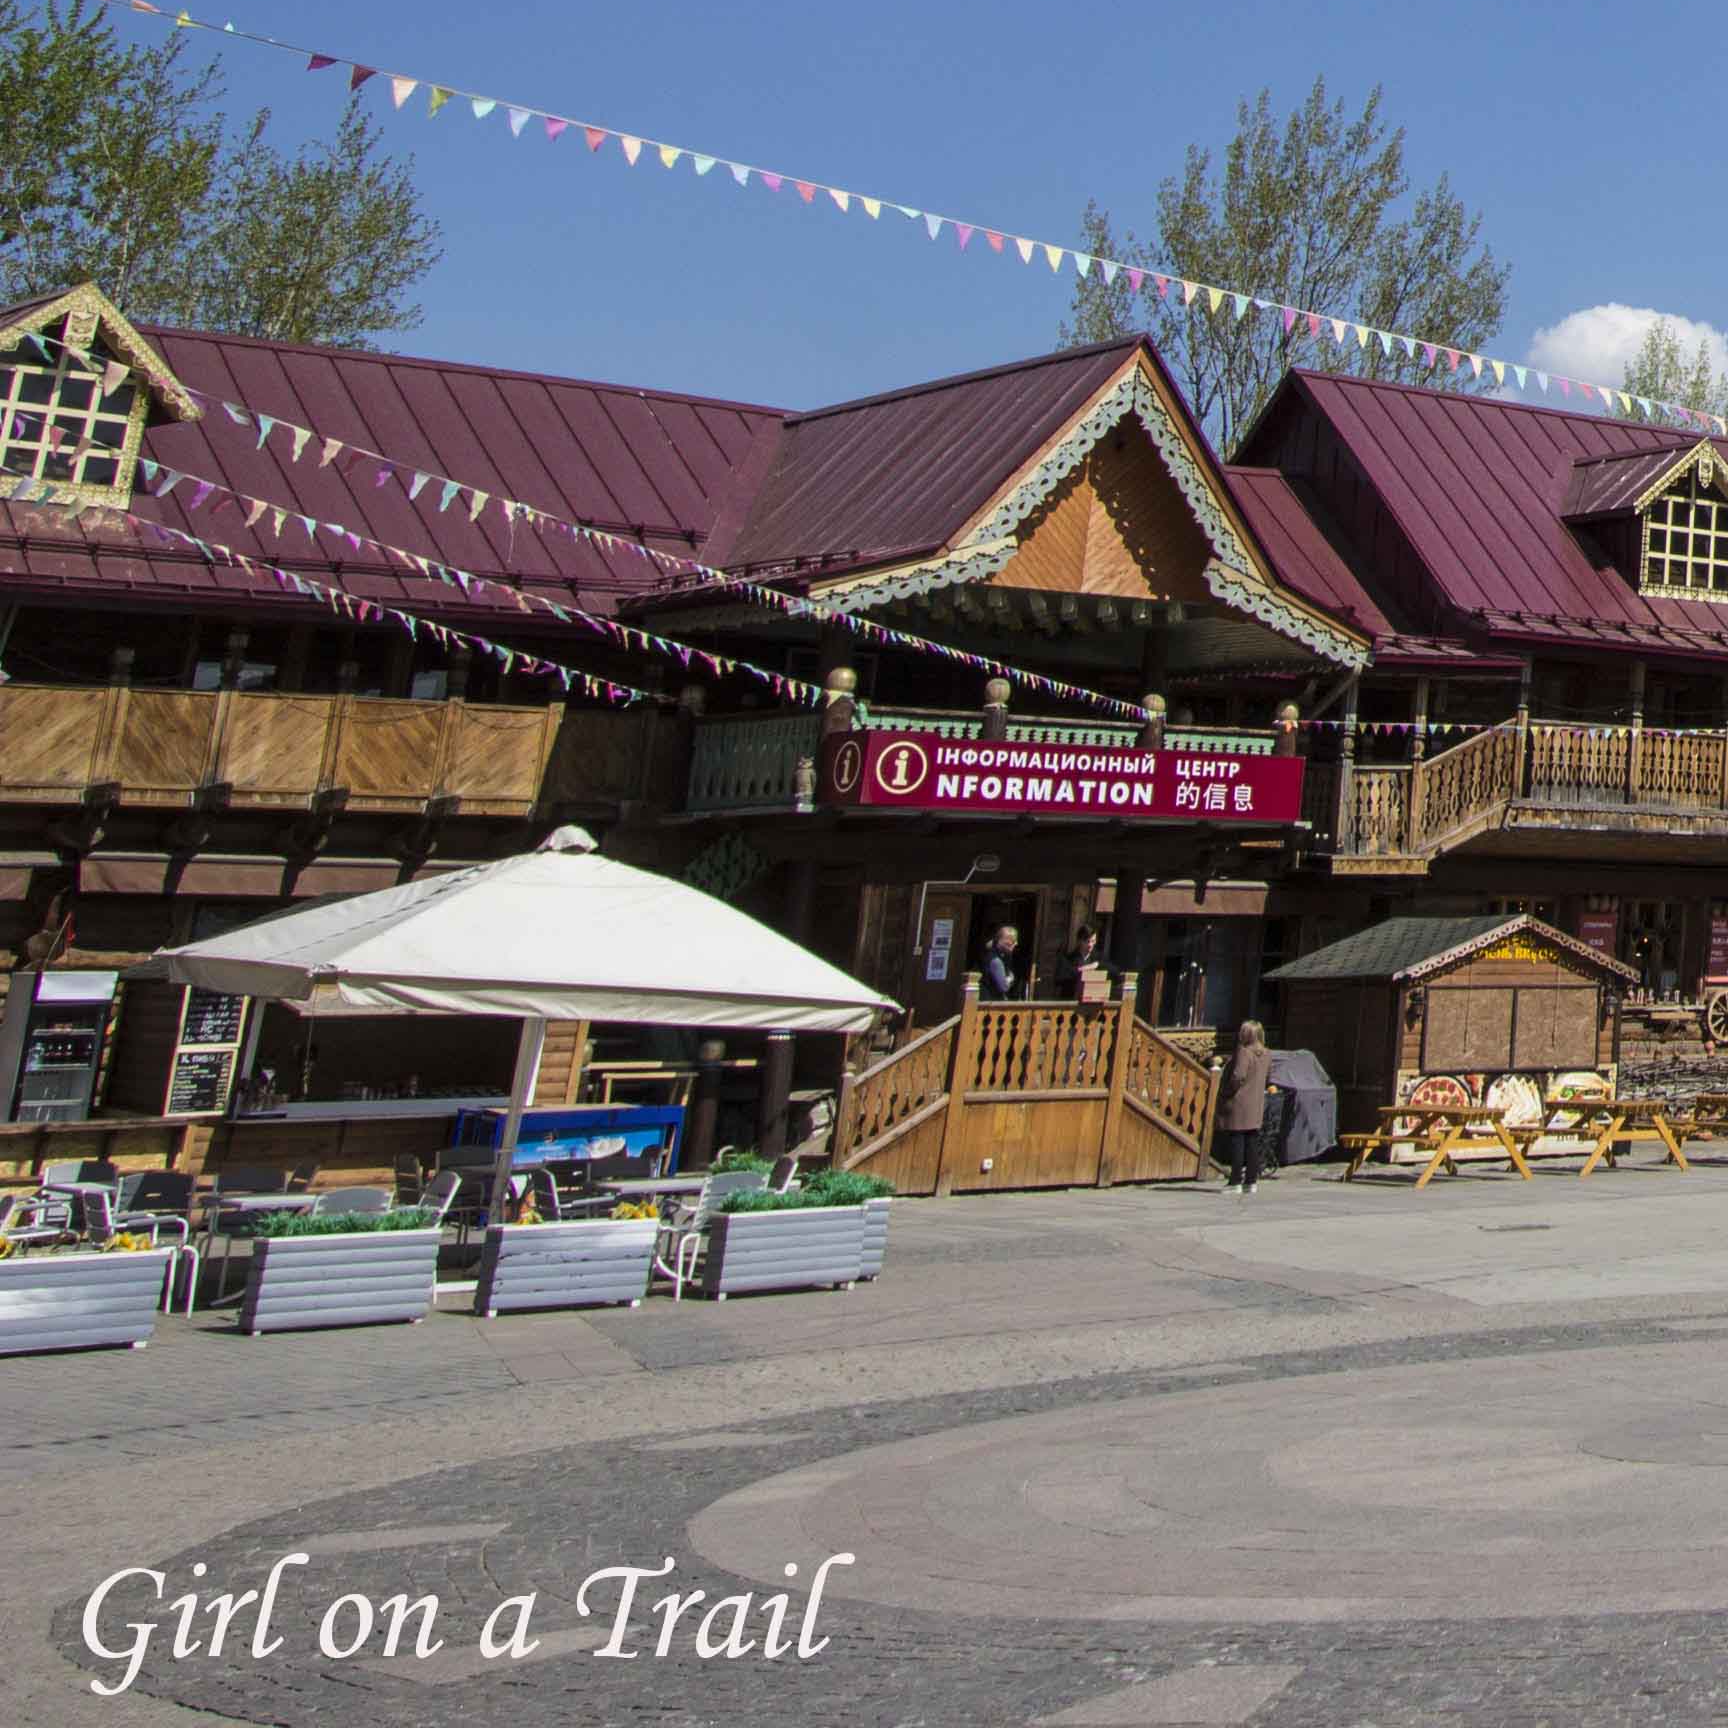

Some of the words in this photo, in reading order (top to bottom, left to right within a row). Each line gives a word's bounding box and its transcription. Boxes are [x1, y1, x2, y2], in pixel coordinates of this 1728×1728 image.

[1176, 759, 1240, 779] ЦЕНТР
[1175, 781, 1254, 811] 的信息
